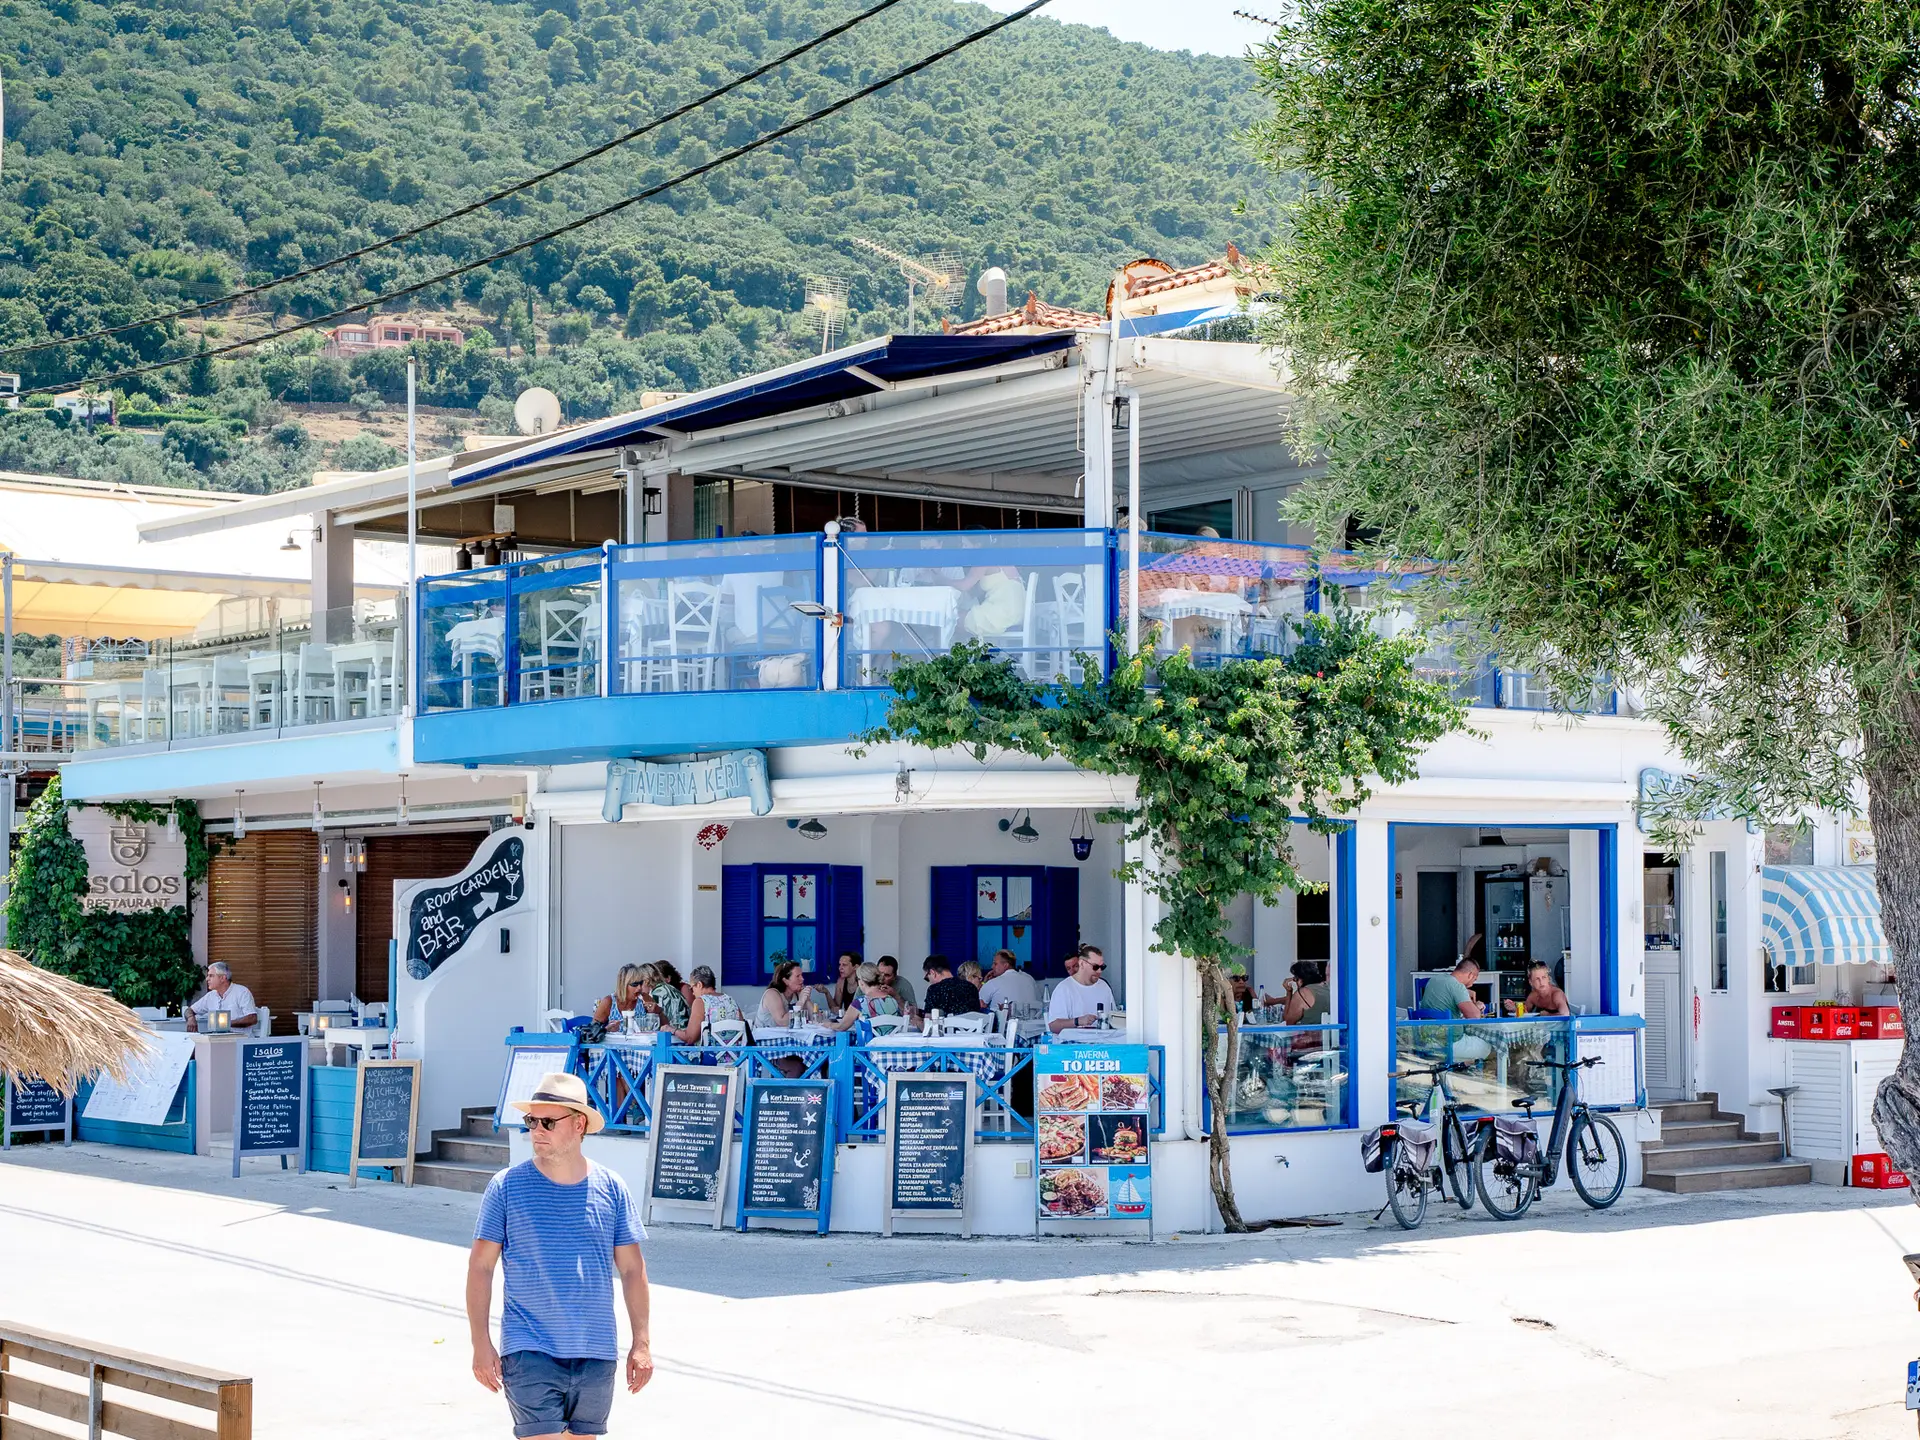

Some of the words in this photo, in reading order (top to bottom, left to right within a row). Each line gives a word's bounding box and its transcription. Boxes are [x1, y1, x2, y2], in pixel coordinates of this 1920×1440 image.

[627, 768, 698, 797] TAVERNA
[704, 762, 740, 792] KERI
[90, 868, 179, 894] salos
[424, 886, 458, 912] ROOF
[460, 858, 510, 896] GARDEN
[86, 898, 170, 910] RESTAURANT
[421, 910, 444, 930] and
[417, 916, 464, 958] BAR
[1882, 1022, 1903, 1030] AMSTEL
[254, 1047, 284, 1056] isalos
[1074, 1051, 1109, 1059] TAVERNA
[1062, 1060, 1082, 1072] TO
[1085, 1060, 1120, 1072] KERI
